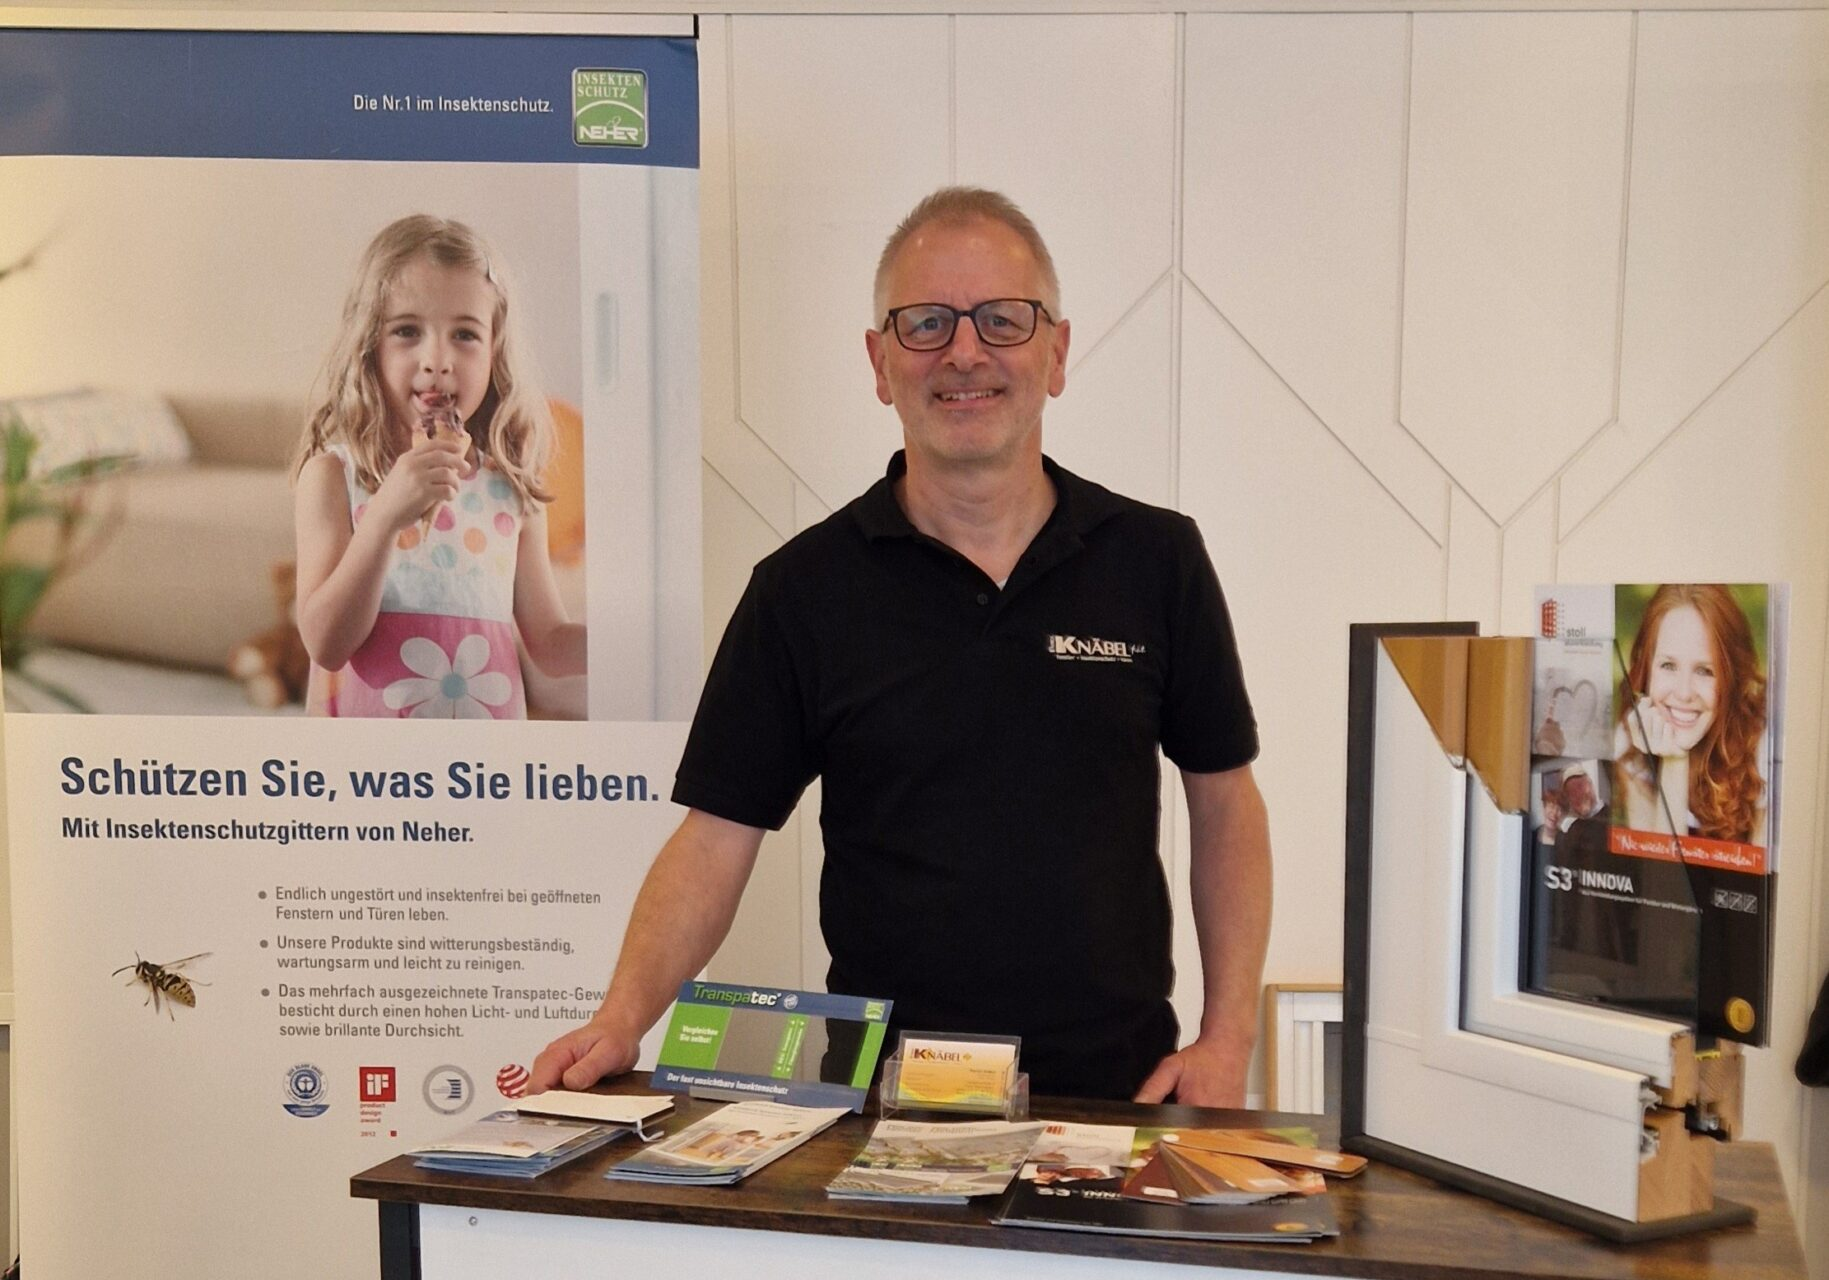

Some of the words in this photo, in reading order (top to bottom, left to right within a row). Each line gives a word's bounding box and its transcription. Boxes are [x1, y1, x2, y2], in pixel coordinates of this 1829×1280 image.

[577, 72, 641, 87] INSEKTEN
[577, 86, 628, 99] SCHUTZ
[353, 94, 378, 111] Die
[417, 96, 434, 112] im
[438, 96, 554, 114] Insektenschutz.
[60, 756, 248, 798] Schützen
[261, 759, 339, 803] Sie,
[349, 769, 435, 800] was
[447, 761, 511, 800] Sie
[524, 762, 660, 802] lieben.
[61, 817, 100, 839] Mit
[105, 818, 350, 846] Insektenschutzgittern
[355, 825, 396, 843] von
[401, 821, 475, 843] Neher.
[1582, 869, 1635, 894] INNOVA
[276, 886, 326, 902] Endlich
[330, 887, 394, 905] ungestört
[398, 887, 422, 901] und
[426, 887, 504, 903] insektenfrei
[507, 888, 528, 903] bei
[531, 889, 601, 907] geöffneten
[276, 907, 334, 920] Fenstern
[339, 907, 363, 920] und
[367, 906, 405, 921] Türen
[408, 906, 449, 922] leben.
[277, 935, 327, 950] Unsere
[331, 936, 393, 950] Produkte
[398, 936, 426, 951] sind
[430, 936, 575, 955] witterungsbeständig,
[277, 957, 370, 974] wartungsarm
[374, 956, 399, 970] und
[403, 956, 442, 970] leicht
[445, 959, 461, 971] zu
[465, 957, 525, 974] reinigen.
[279, 984, 305, 998] Das
[309, 984, 375, 999] mehrfach
[380, 985, 488, 1003] ausgezeichnete
[492, 985, 606, 1003] Transpatec-Gew
[693, 984, 779, 1005] Transpatec
[279, 1003, 334, 1018] besticht
[338, 1004, 378, 1018] durch
[383, 1005, 421, 1018] einen
[425, 1004, 467, 1018] hohen
[472, 1005, 511, 1019] Licht-
[515, 1005, 539, 1020] und
[279, 1023, 321, 1037] sowie
[325, 1023, 381, 1037] brillante
[385, 1023, 464, 1038] Durchsicht.
